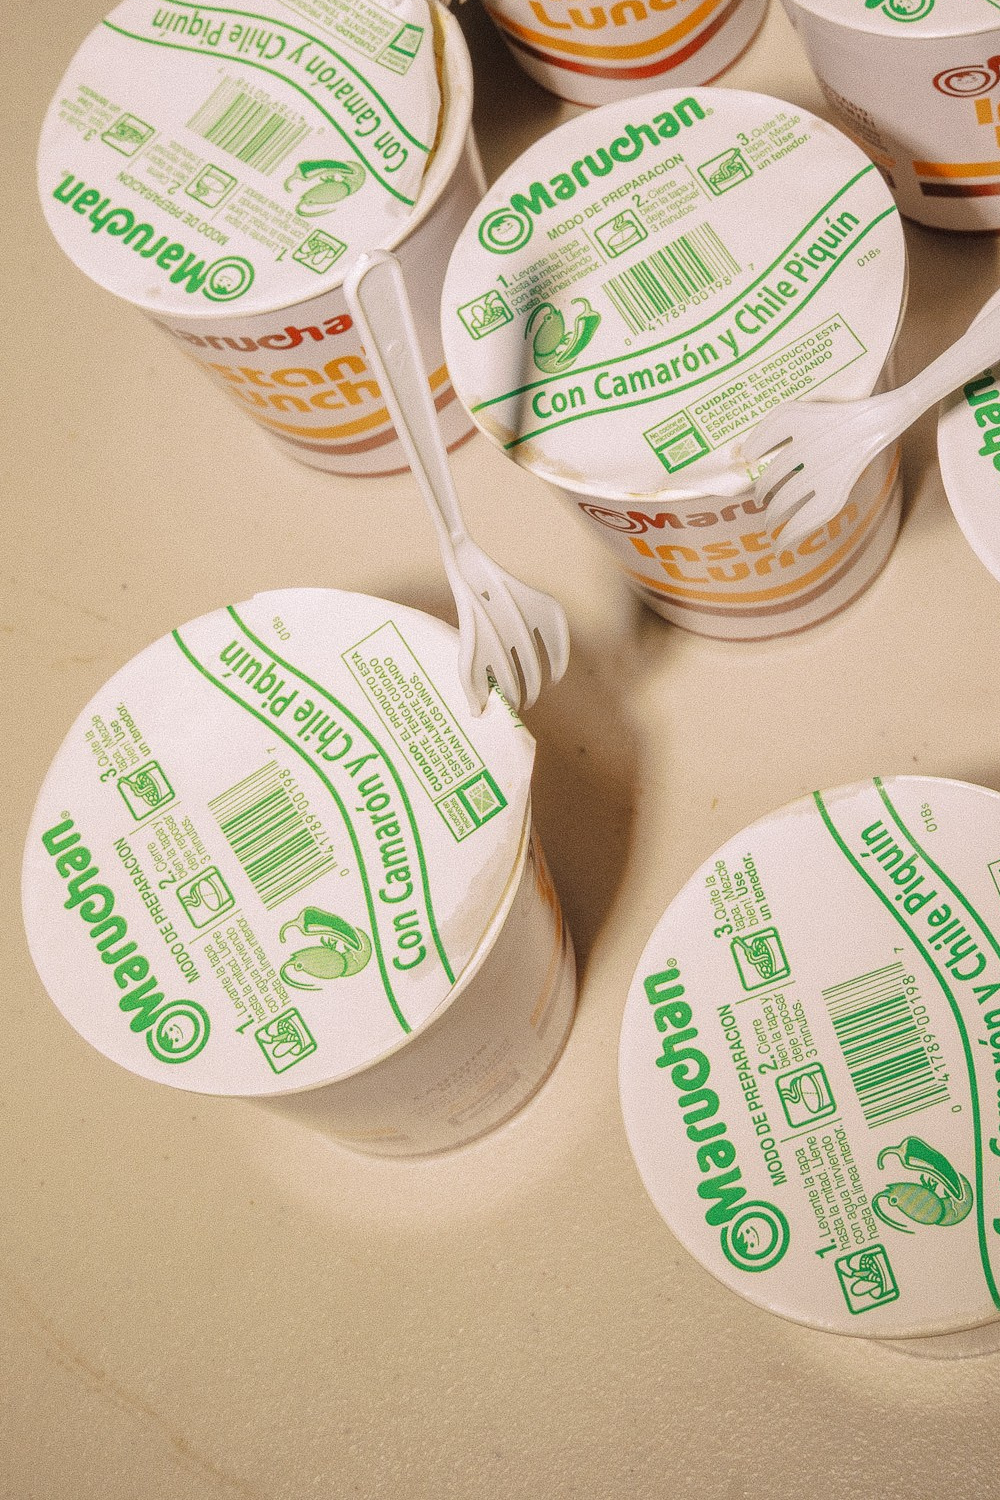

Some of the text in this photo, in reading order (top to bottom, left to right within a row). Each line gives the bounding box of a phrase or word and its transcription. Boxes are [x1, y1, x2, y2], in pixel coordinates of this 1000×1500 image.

[153, 7, 409, 173] Con Camarón y Chile Piquín
[510, 97, 707, 216] Maruchan
[53, 174, 208, 294] Maruchan
[546, 153, 686, 242] MODO DE PREPARACION
[532, 207, 862, 420] Con Camarón y Chile Piquín
[219, 639, 427, 972] Con Camarón y Chile Piquín
[921, 803, 937, 832] 018s
[715, 861, 750, 932] tapa. ¡Mezcle
[734, 872, 759, 927] bien! Use
[743, 853, 772, 921] un tenedor.
[861, 819, 938, 914] Piquín
[41, 819, 166, 1033] Maruchan
[705, 875, 733, 938] 3. Quite la
[933, 904, 987, 981] Chile
[763, 1001, 787, 1031] tapa
[772, 1031, 782, 1043] la
[774, 994, 810, 1062] deje reposar
[792, 1002, 817, 1058] 3 minutos.
[900, 975, 930, 1025] 00198
[753, 1019, 778, 1074] 2. Cierre
[776, 1044, 791, 1069] bien
[923, 1034, 949, 1082] 41789
[643, 967, 747, 1227] Maruchan
[718, 1004, 787, 1186] MODO DE PREPARACION
[951, 1105, 962, 1113] 0
[795, 1146, 837, 1258] 1. Levante la tapa
[807, 1136, 851, 1251] hasta la mitad. Llene
[822, 1136, 865, 1244] con agua hirviendo
[834, 1125, 879, 1240] hasta la línea interior.
